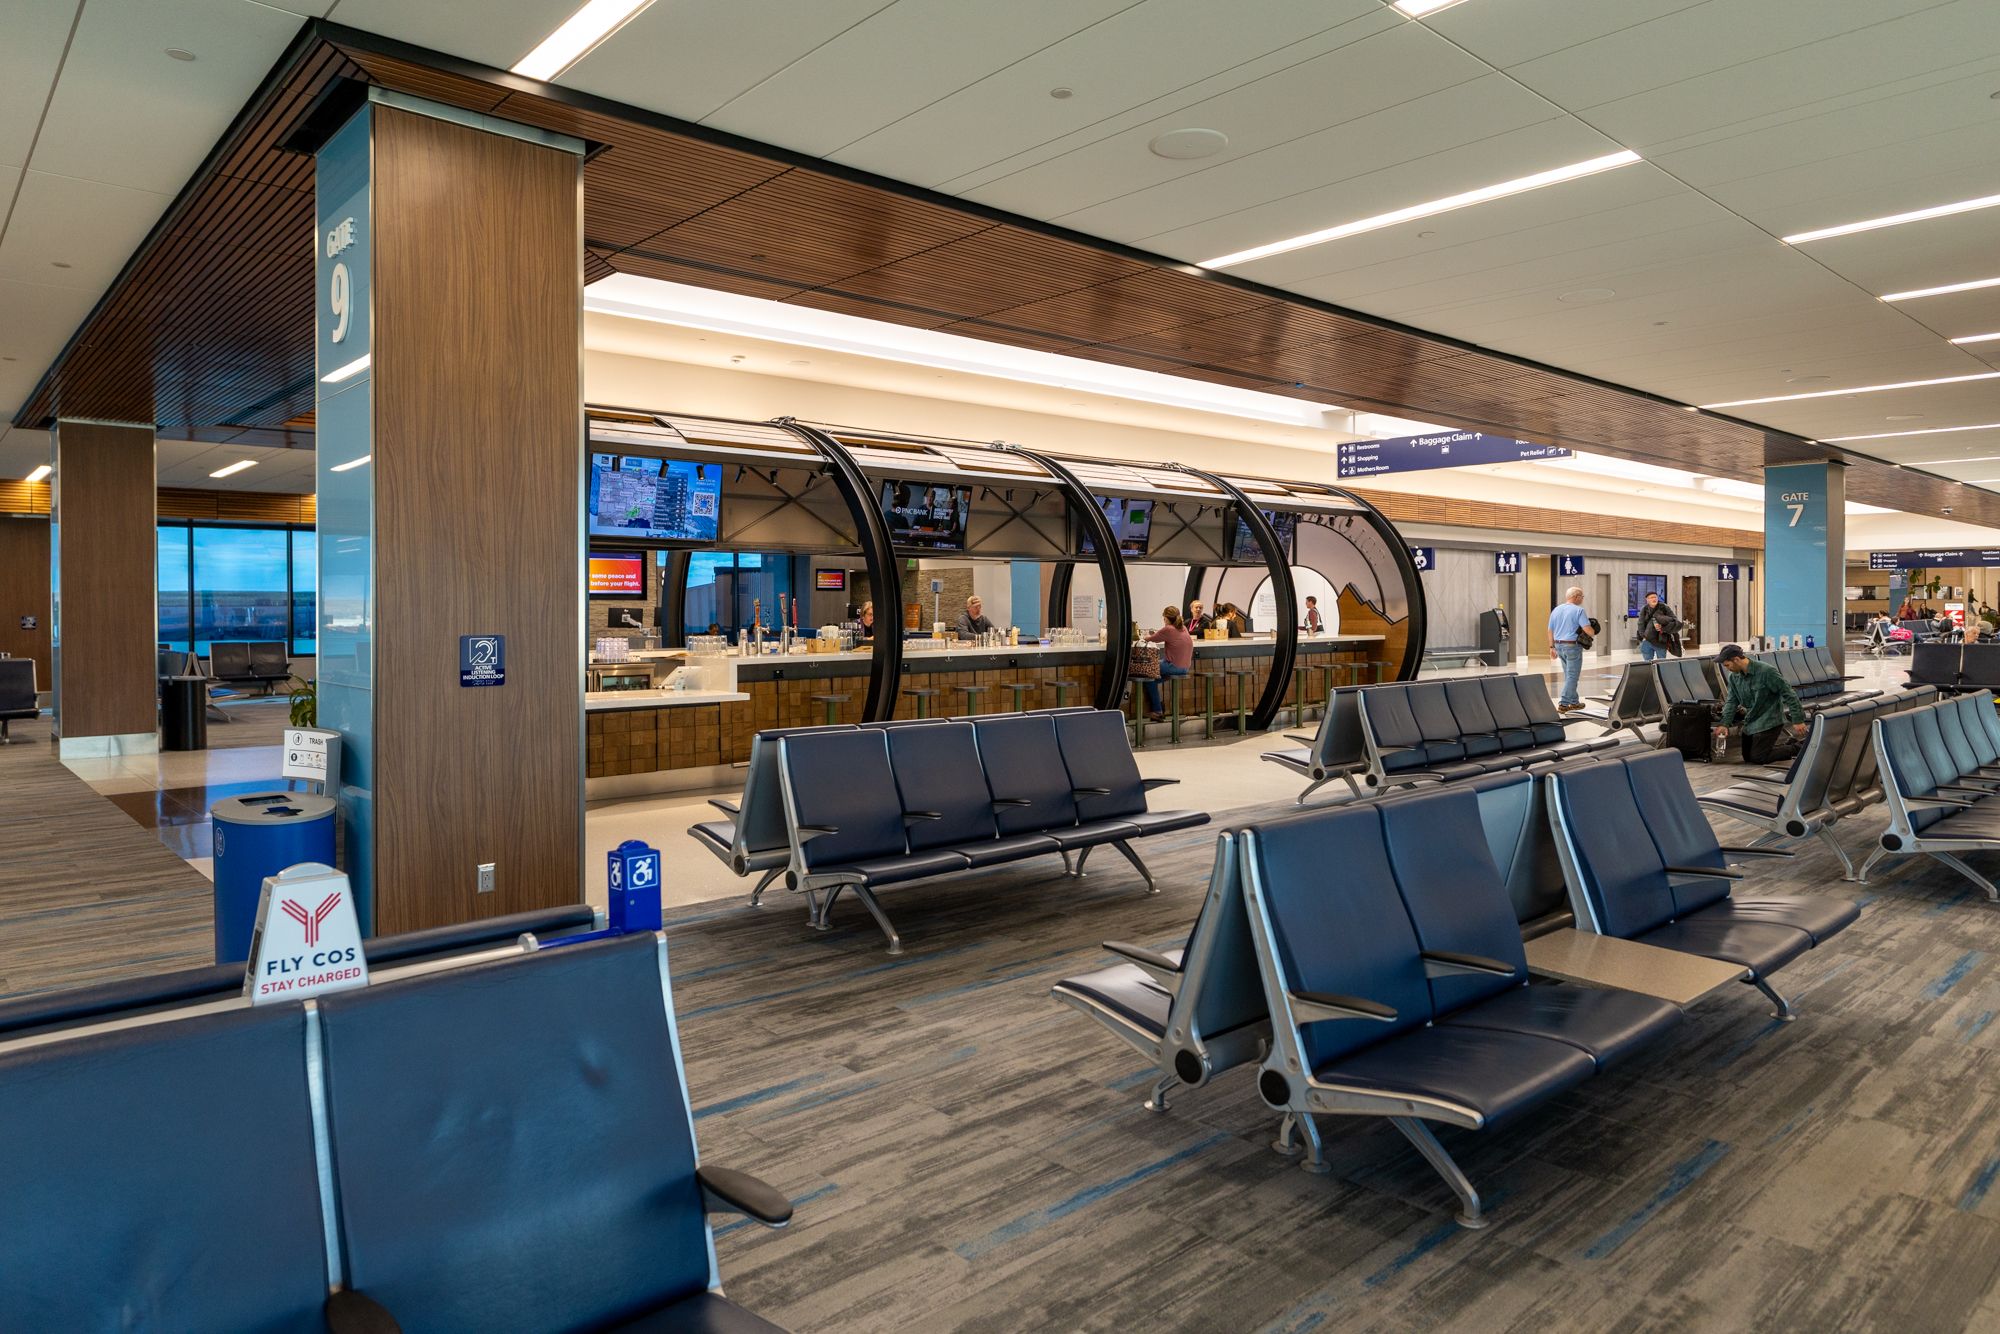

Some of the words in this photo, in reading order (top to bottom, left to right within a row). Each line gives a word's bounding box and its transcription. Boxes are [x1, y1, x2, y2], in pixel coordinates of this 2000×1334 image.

[331, 262, 350, 343] 9
[1419, 435, 1451, 446] Baggage
[1451, 433, 1473, 442] Claim
[1781, 492, 1809, 502] GATE
[913, 508, 928, 516] BANK
[1786, 504, 1804, 527] 7
[309, 737, 323, 746] TRASH
[267, 955, 304, 976] FLY
[312, 947, 356, 967] COS
[261, 979, 295, 995] STAY
[298, 967, 361, 988] CHARGED
